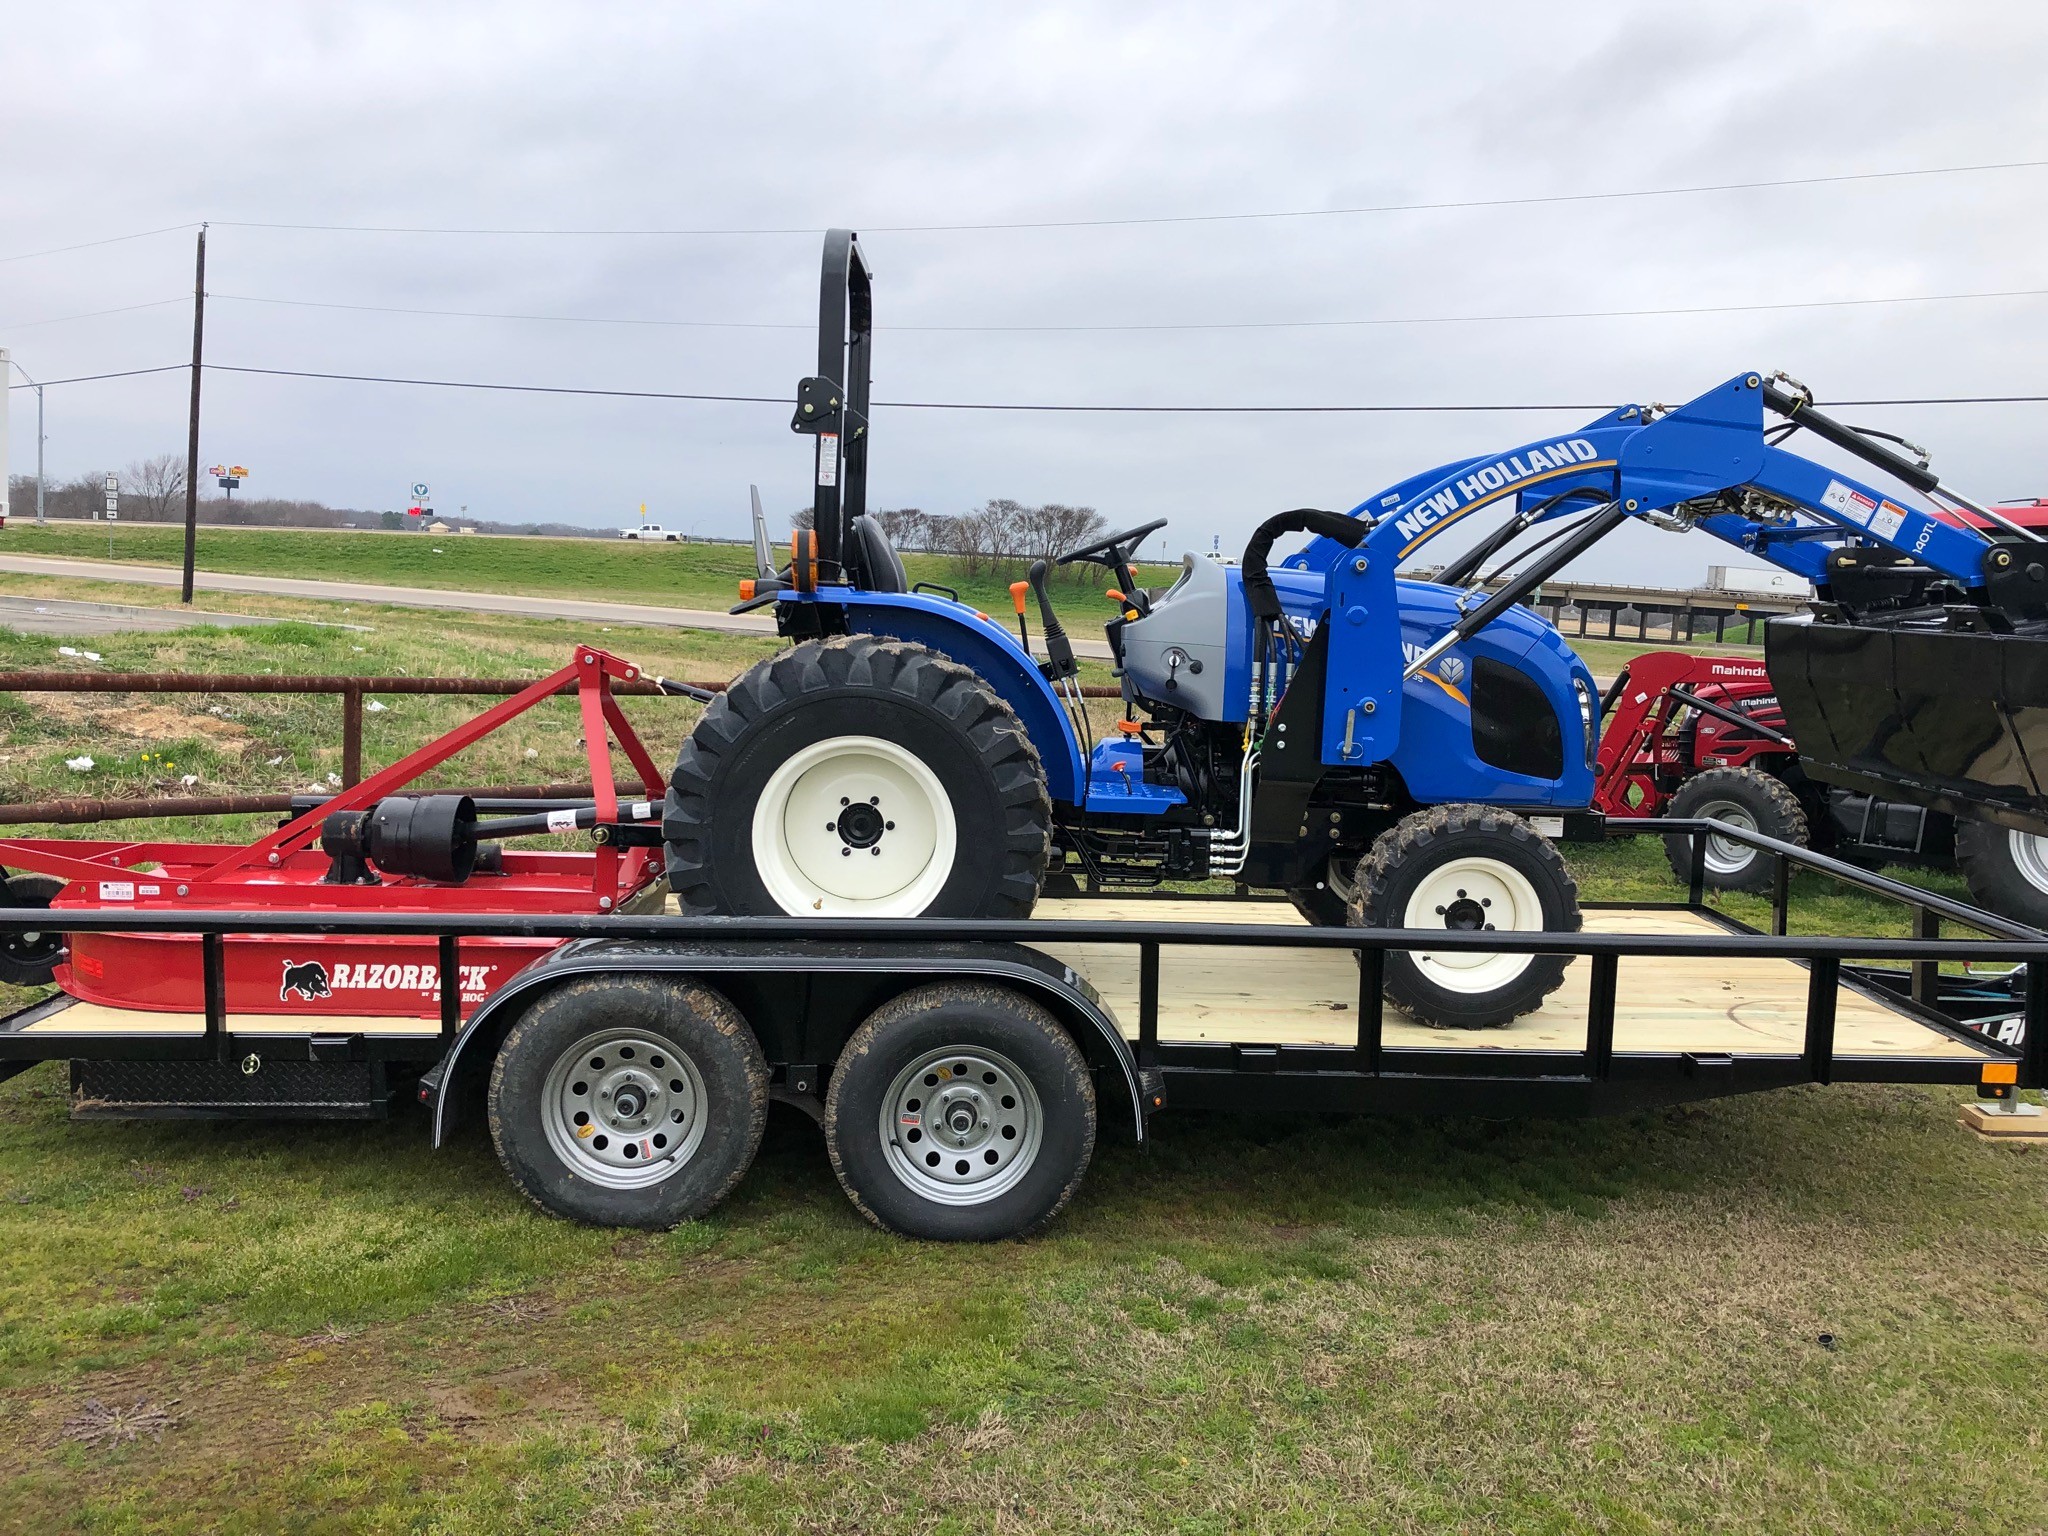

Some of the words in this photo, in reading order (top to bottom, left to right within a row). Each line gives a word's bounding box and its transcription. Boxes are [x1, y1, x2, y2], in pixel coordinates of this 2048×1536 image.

[1395, 487, 1460, 542] NEW
[1456, 439, 1598, 501] HOLLAND
[1912, 521, 1938, 554] 140TL
[1711, 664, 1767, 677] Mahindr
[1741, 697, 1778, 707] Mahind
[461, 992, 485, 1003] HOG
